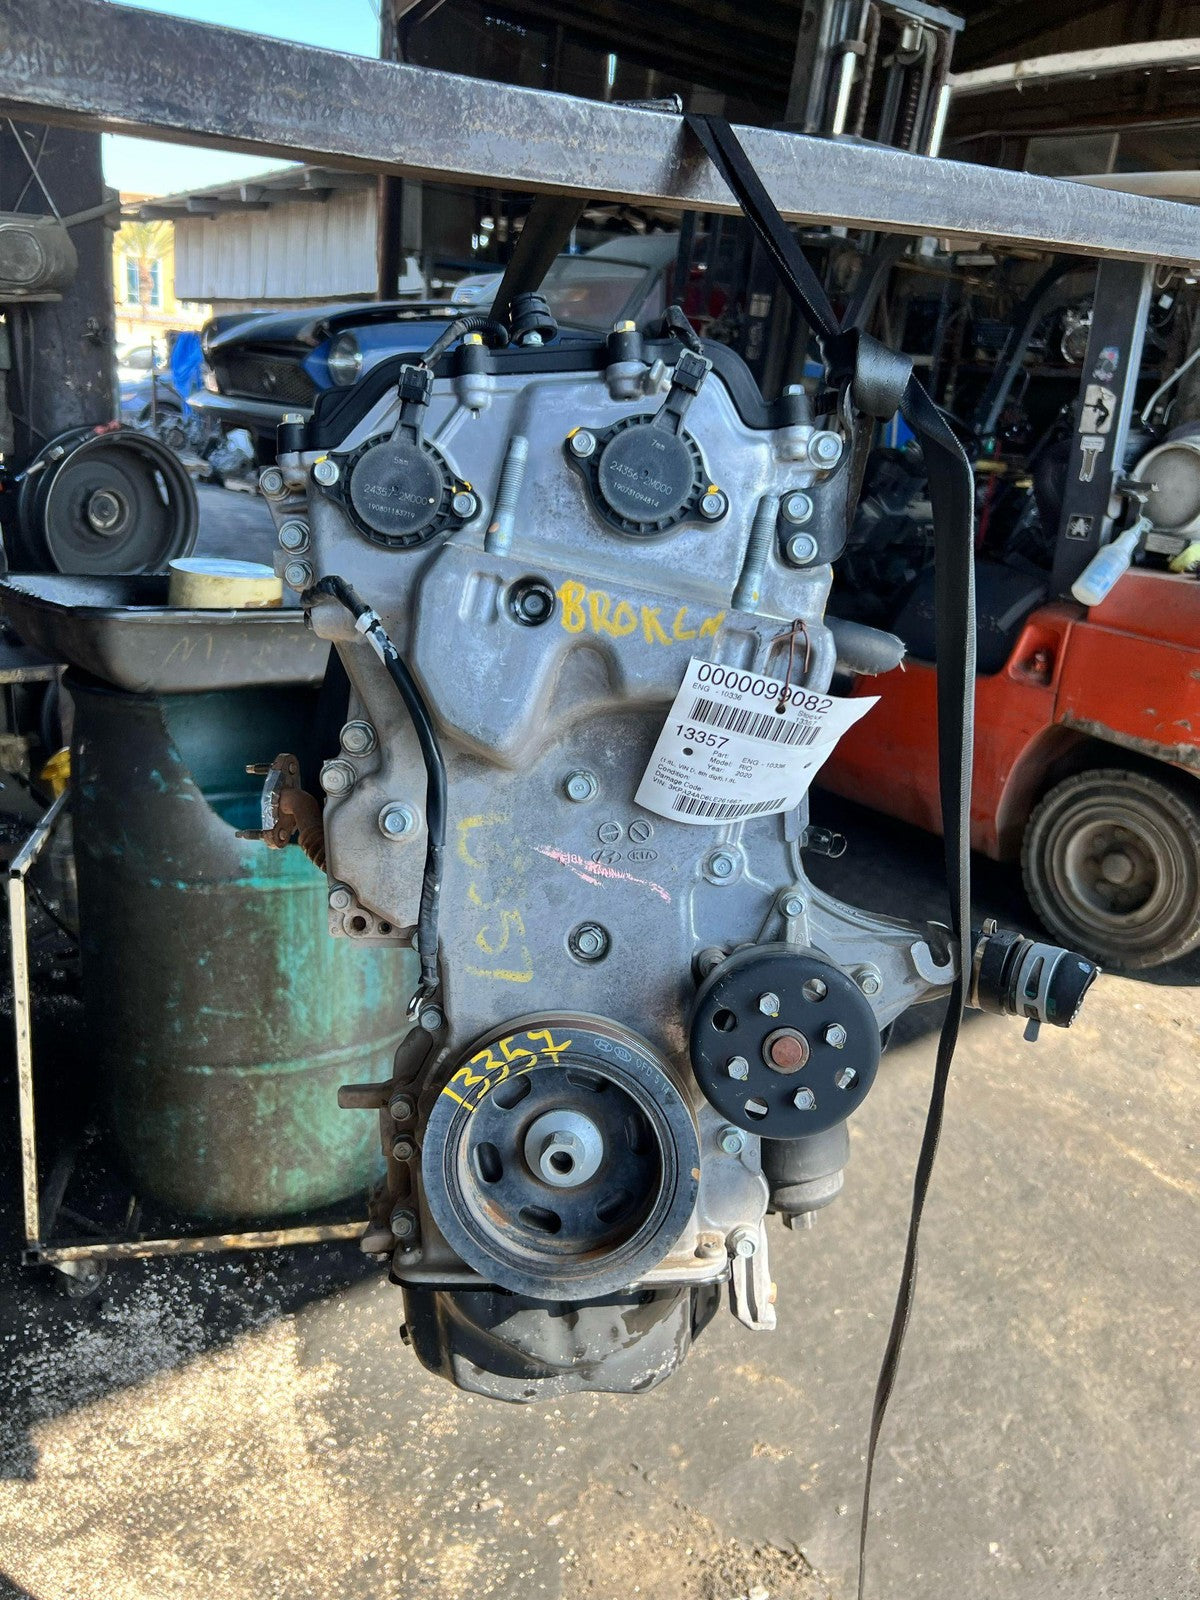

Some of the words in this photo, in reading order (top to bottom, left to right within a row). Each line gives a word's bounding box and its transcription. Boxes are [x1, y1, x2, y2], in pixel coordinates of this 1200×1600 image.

[609, 460, 673, 496] 24356-2M000
[692, 682, 710, 693] ENG
[698, 664, 833, 714] 0000099082
[676, 724, 730, 749] 13357
[654, 770, 683, 786] Damage
[735, 771, 752, 779] 2020
[443, 1029, 572, 1113] 13357
